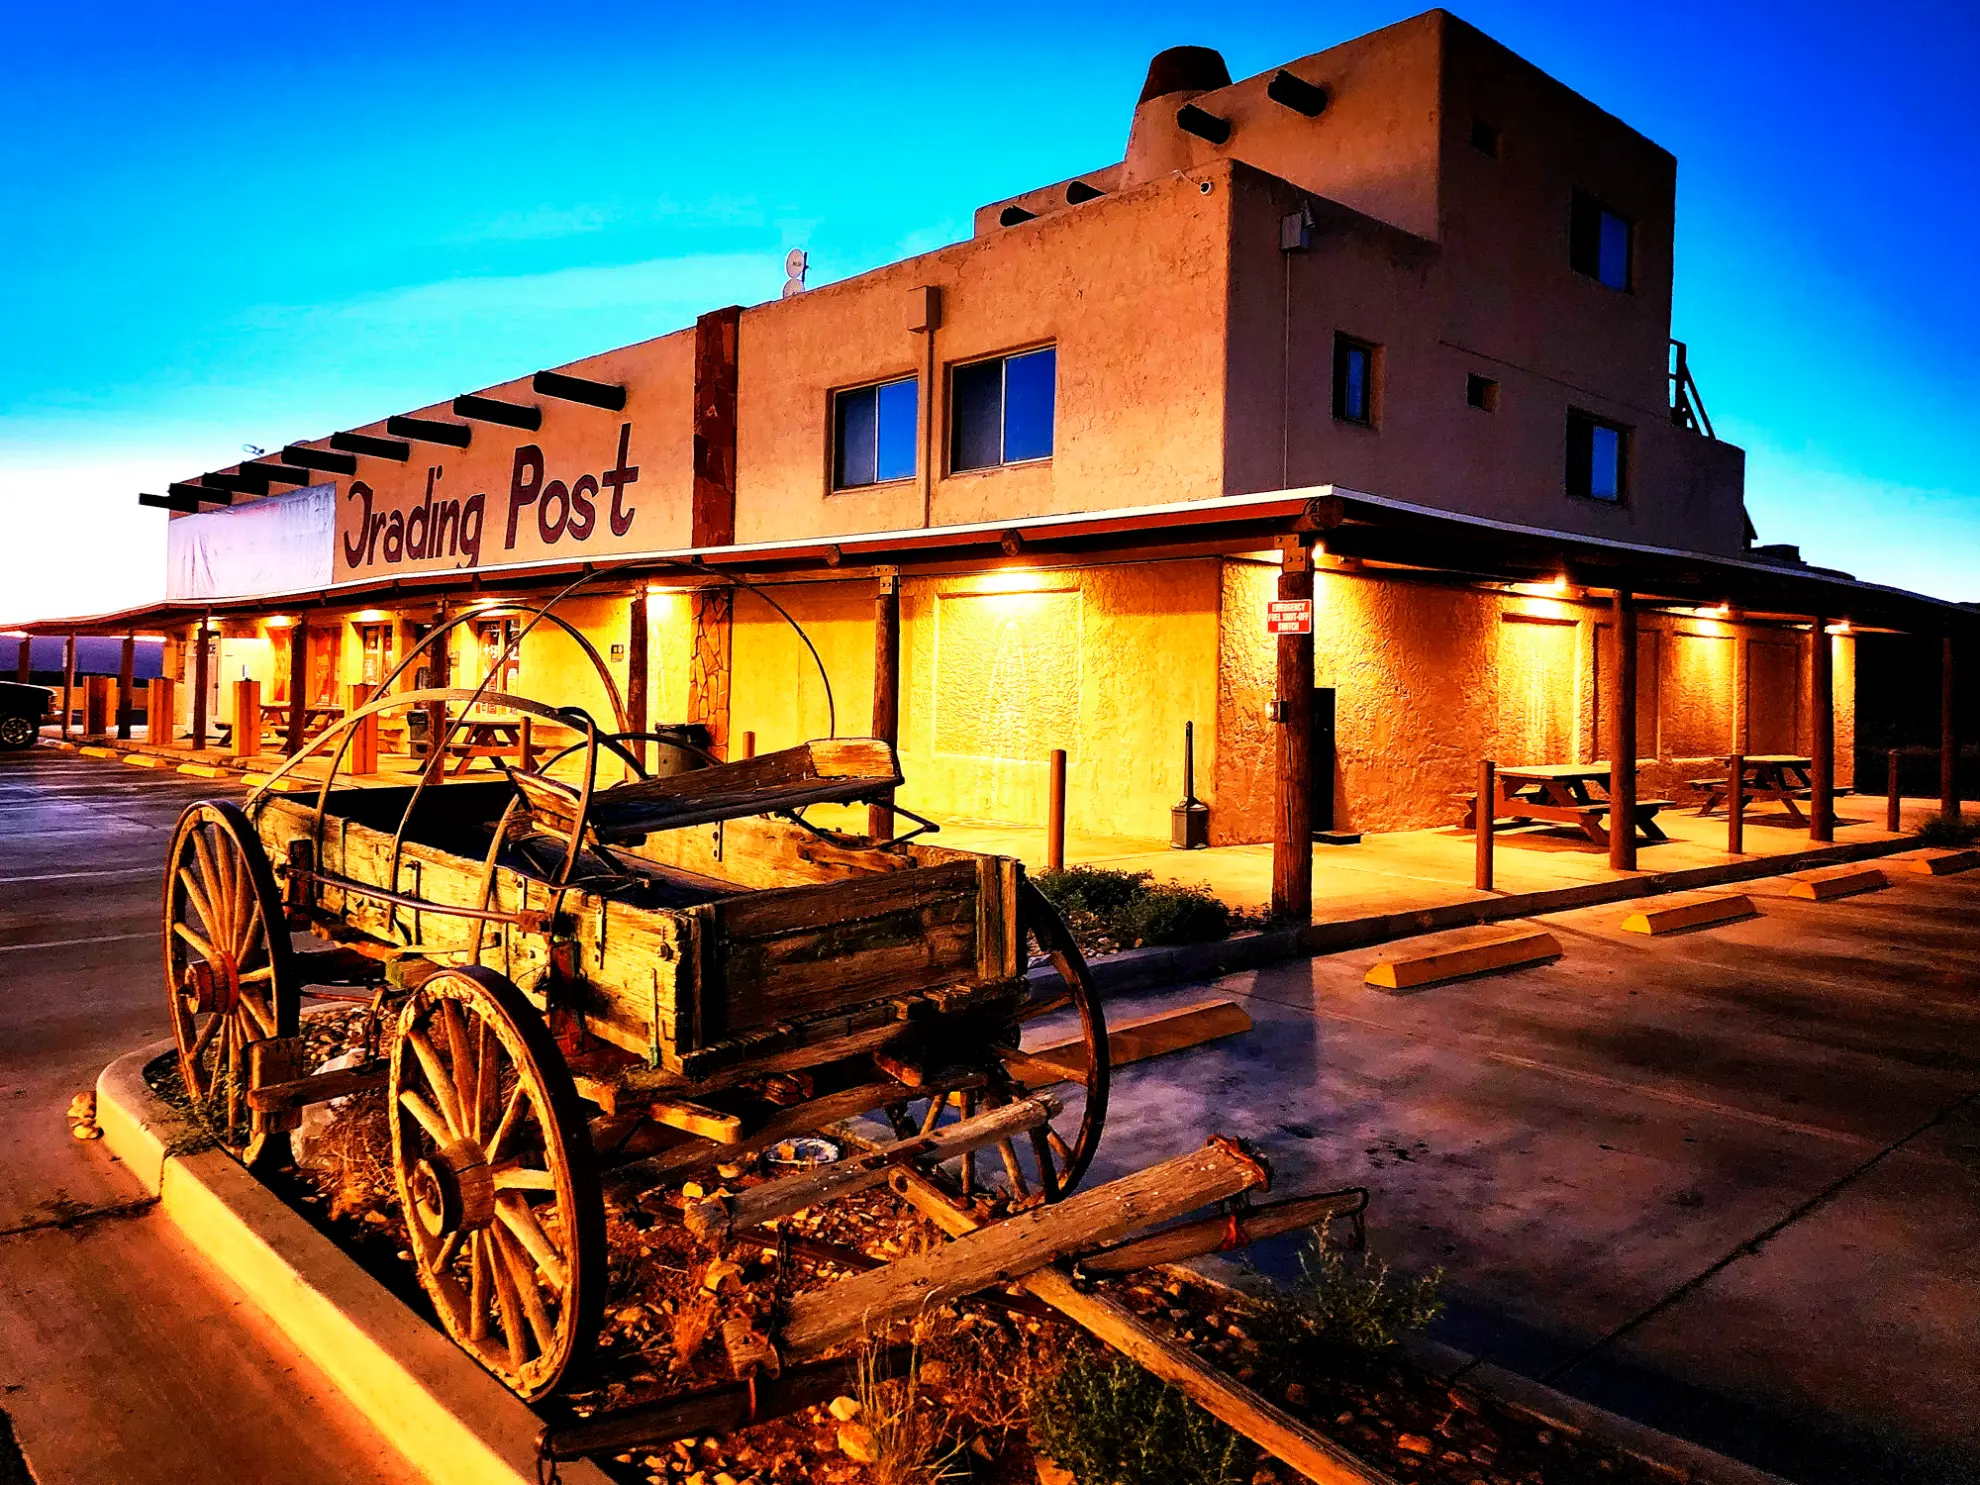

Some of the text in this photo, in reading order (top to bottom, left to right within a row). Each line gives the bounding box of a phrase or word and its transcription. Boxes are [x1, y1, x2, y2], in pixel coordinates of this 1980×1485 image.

[504, 423, 640, 550] Post
[1272, 603, 1305, 612] EMERGENCY
[1278, 622, 1300, 631] SWITCH
